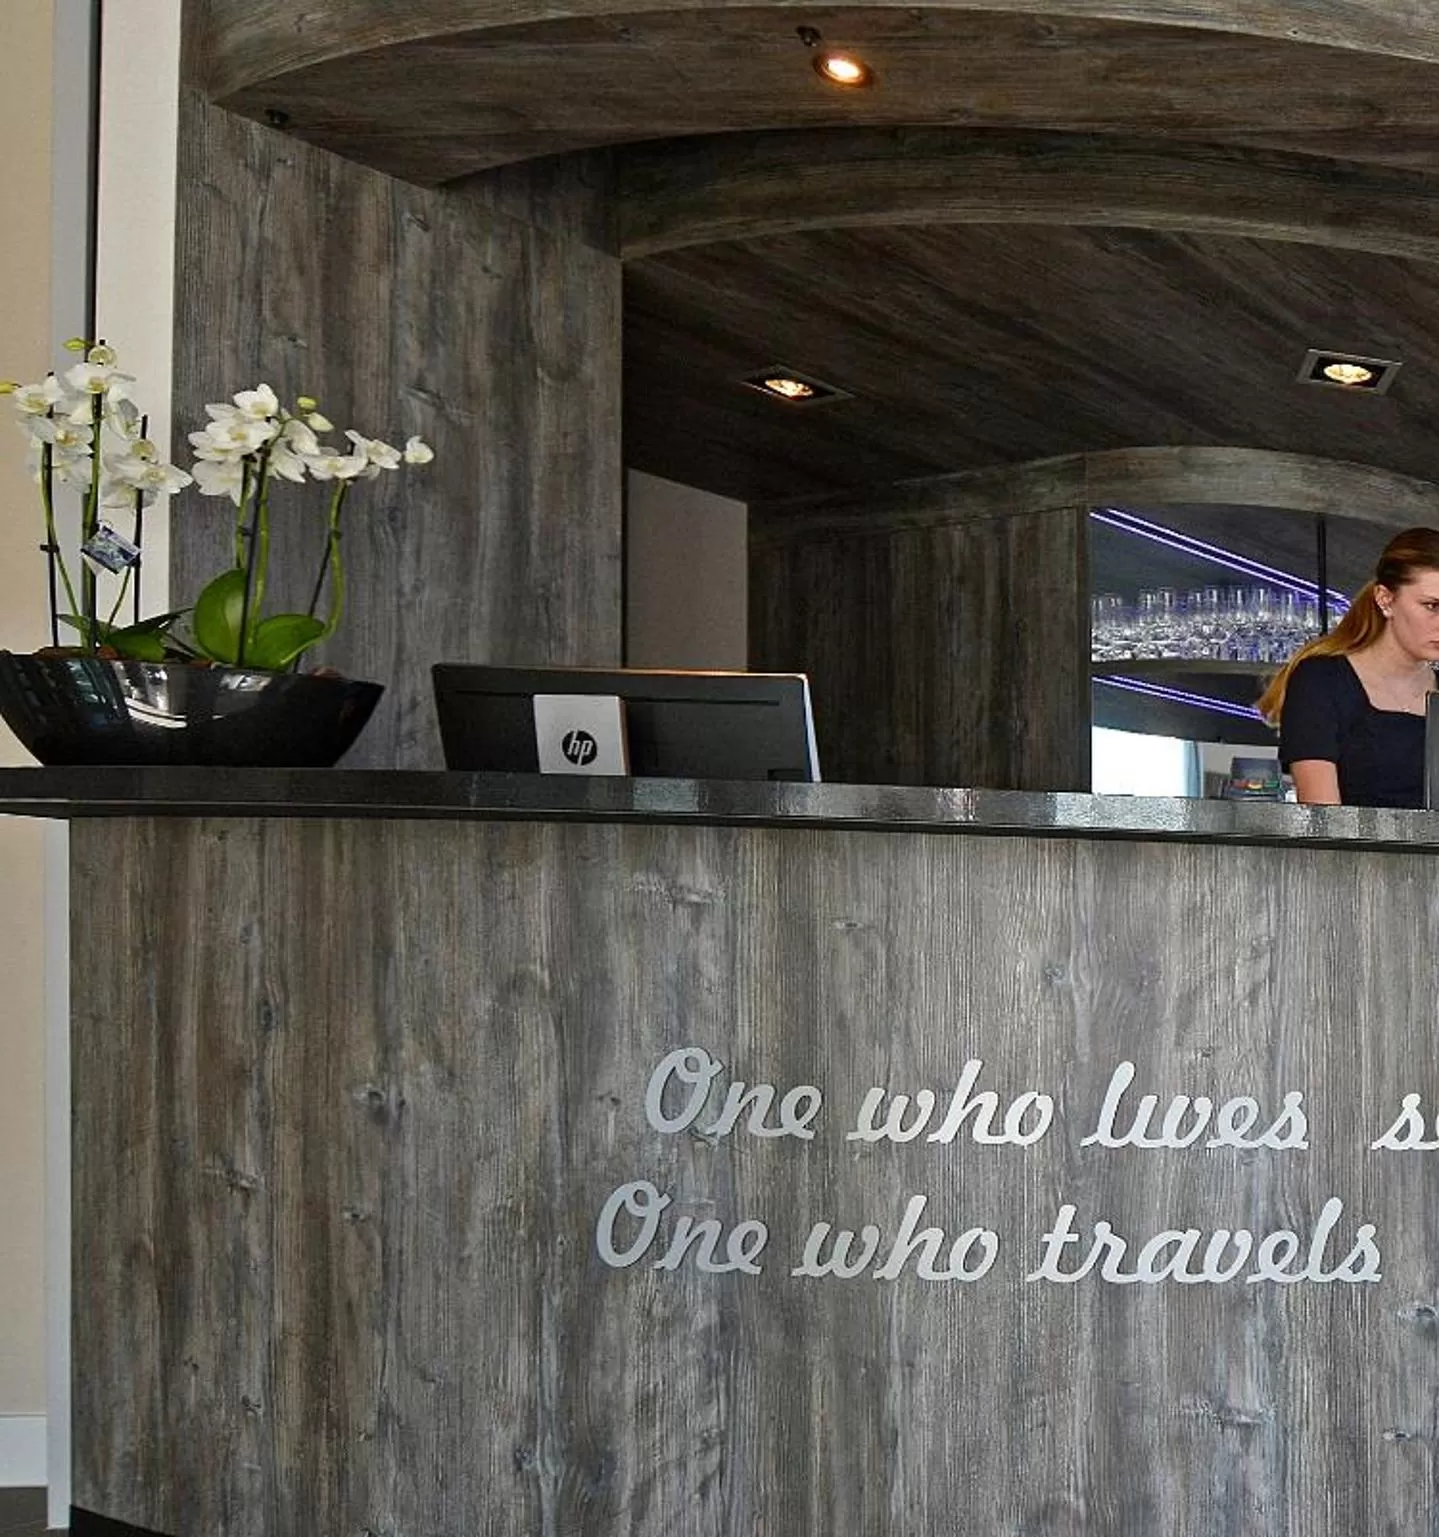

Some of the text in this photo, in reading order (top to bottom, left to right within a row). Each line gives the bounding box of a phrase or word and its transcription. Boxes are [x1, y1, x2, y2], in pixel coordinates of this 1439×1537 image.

[566, 730, 594, 765] hp
[645, 1047, 822, 1140] One
[846, 1059, 1053, 1143] who
[1081, 1061, 1309, 1149] lives
[596, 1180, 769, 1275] One
[791, 1195, 999, 1281] who
[1025, 1197, 1382, 1283] travels
